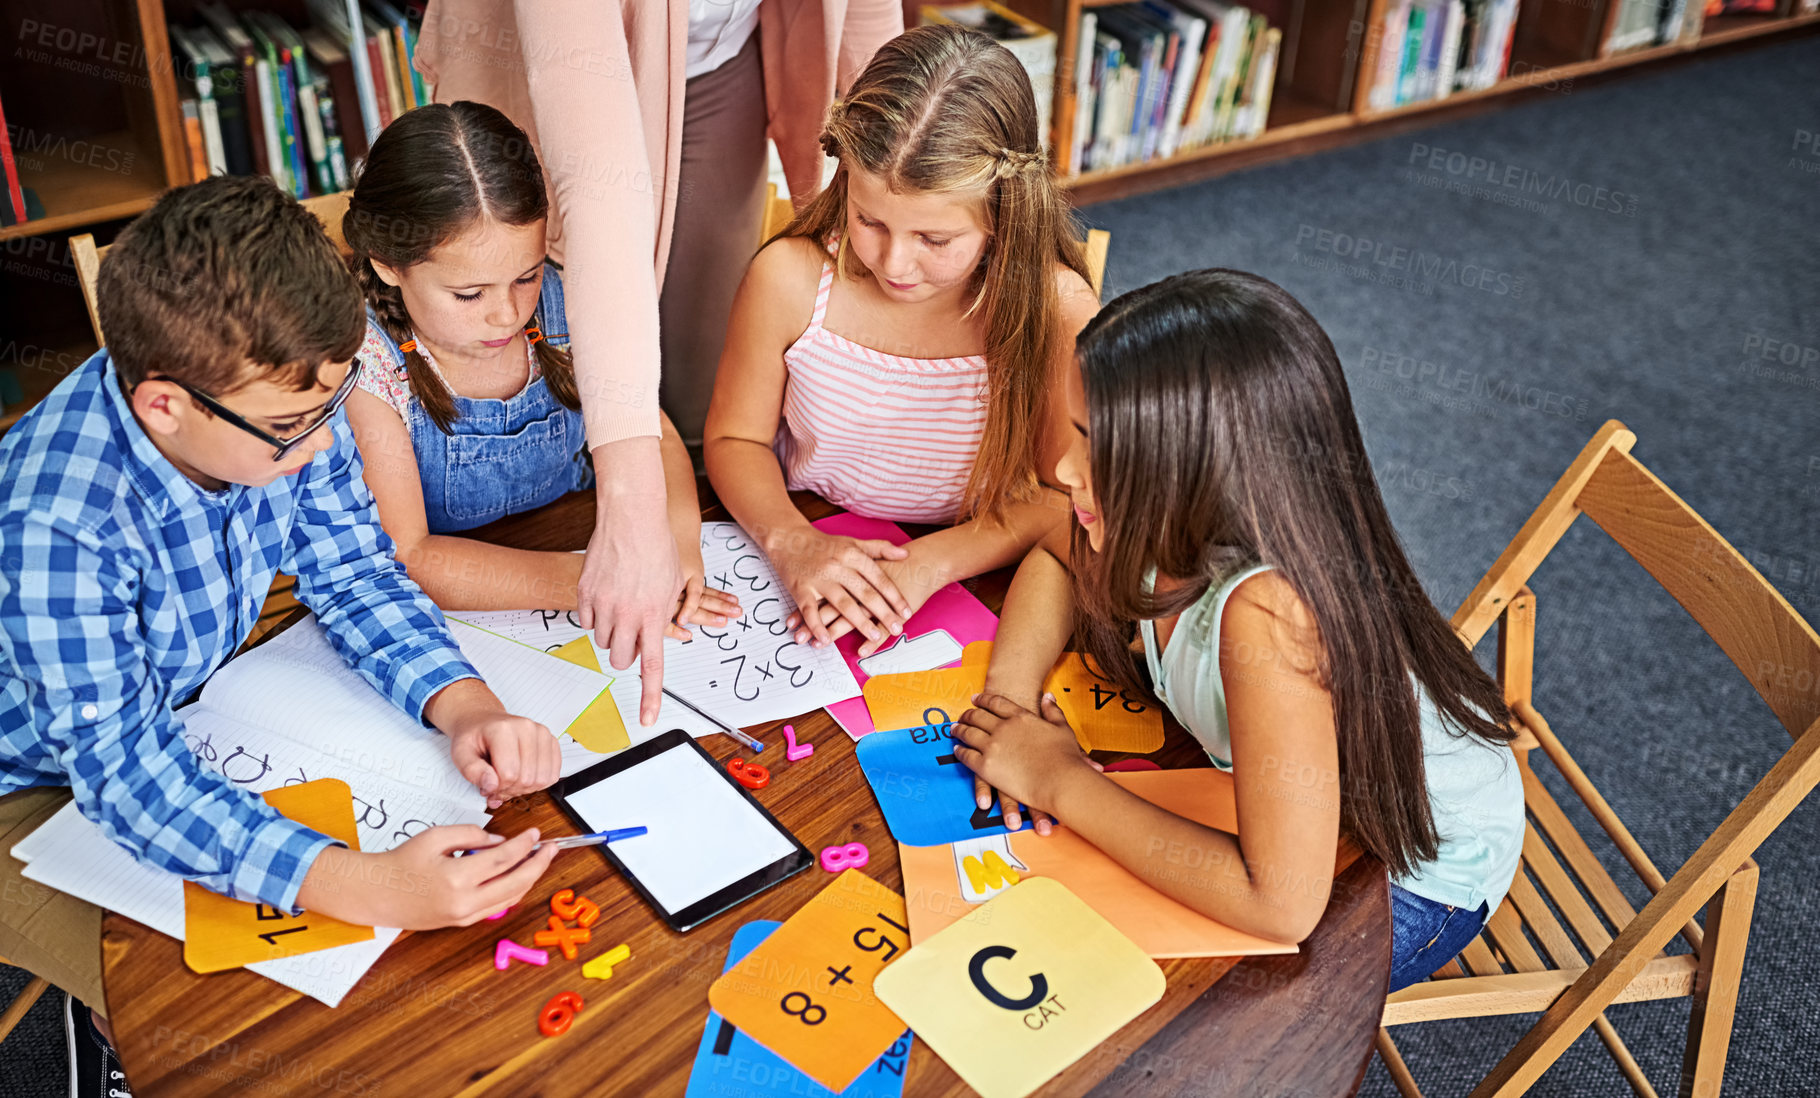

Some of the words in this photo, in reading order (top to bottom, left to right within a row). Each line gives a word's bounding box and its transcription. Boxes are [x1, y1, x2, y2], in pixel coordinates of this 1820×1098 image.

[820, 841, 870, 873] 8
[967, 945, 1049, 1012] C
[1022, 993, 1067, 1031] CAT
